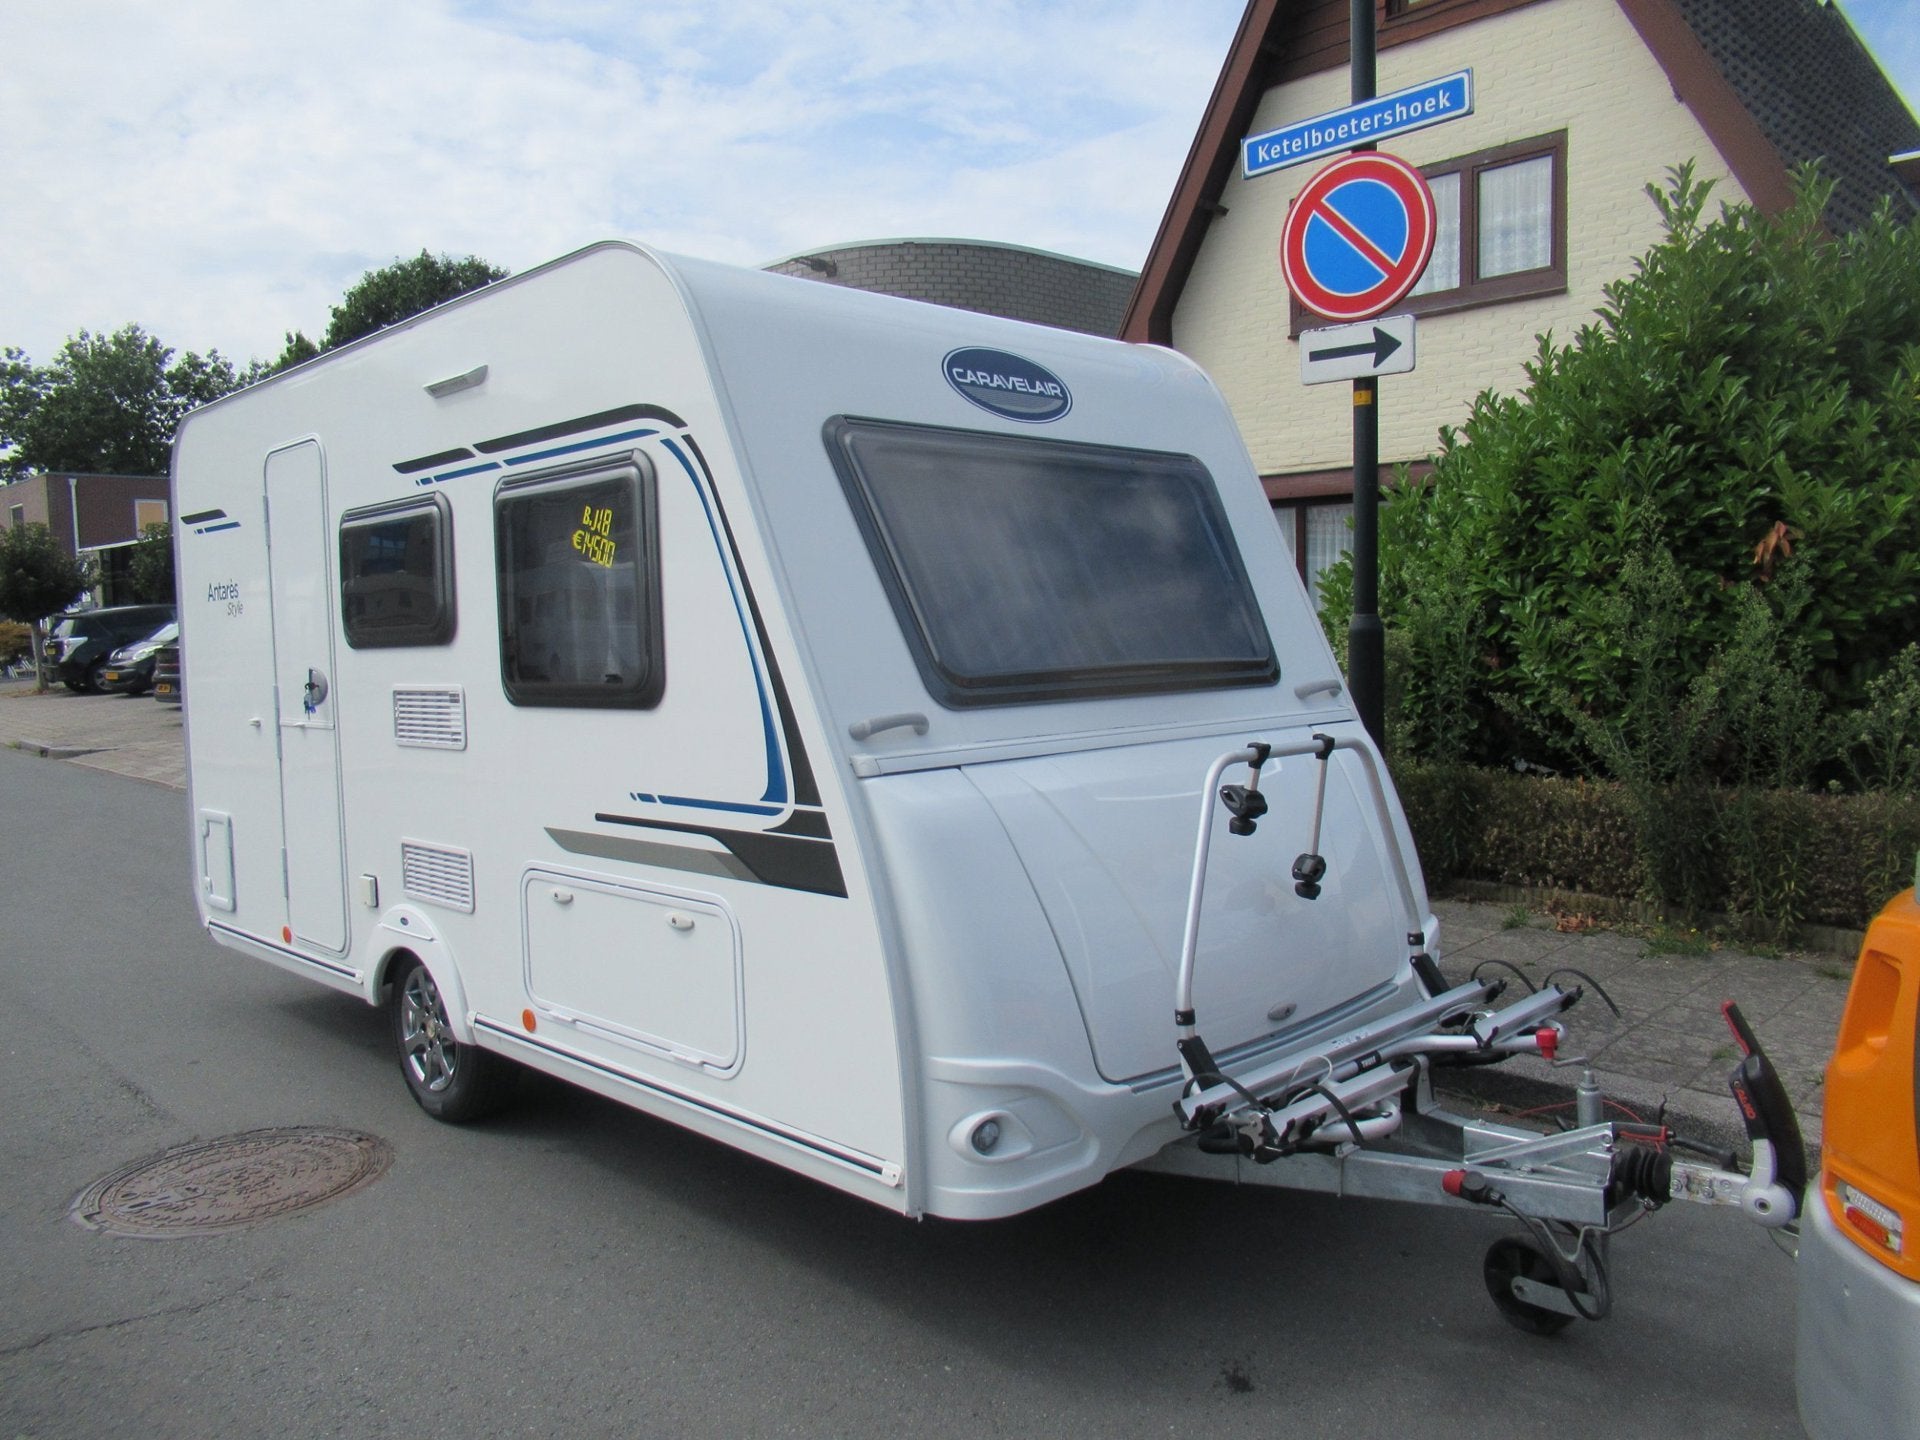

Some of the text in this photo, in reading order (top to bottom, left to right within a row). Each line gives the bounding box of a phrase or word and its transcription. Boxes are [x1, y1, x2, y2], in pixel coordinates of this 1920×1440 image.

[1258, 89, 1451, 163] Ketelboetershoek
[952, 367, 1063, 397] CARAVELAIR
[208, 579, 239, 602] Antarès
[227, 600, 244, 617] Style
